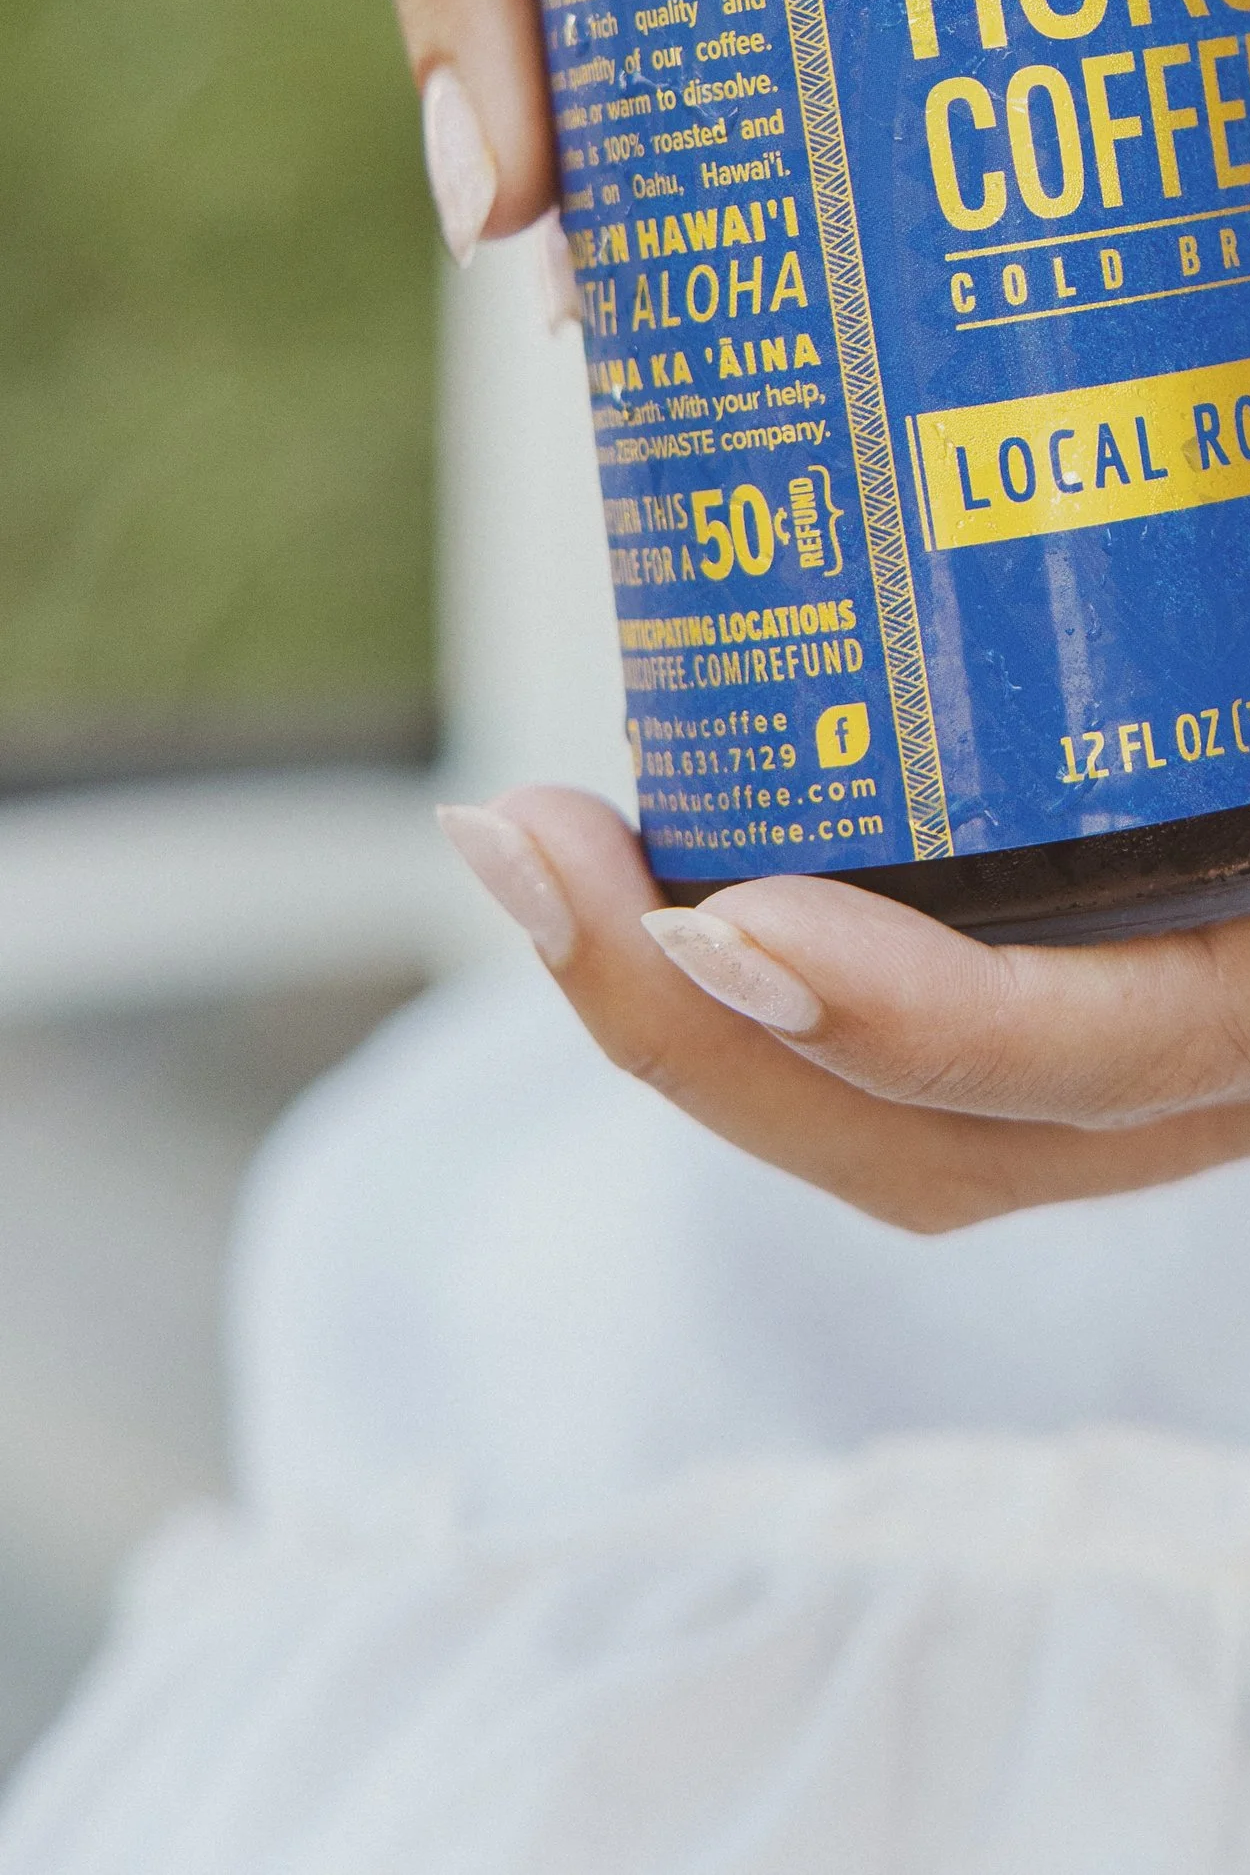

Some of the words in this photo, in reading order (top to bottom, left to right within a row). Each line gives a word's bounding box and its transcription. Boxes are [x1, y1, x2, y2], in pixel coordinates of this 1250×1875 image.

[624, 47, 641, 74] of
[652, 45, 683, 70] our
[696, 30, 773, 62] coffee.
[607, 93, 652, 121] warm
[656, 87, 676, 111] to
[684, 71, 779, 108] dissolve.
[604, 133, 646, 165] 100%
[652, 117, 727, 154] roasted
[741, 108, 785, 141] and
[602, 184, 620, 206] on
[632, 171, 684, 200] Oahu,
[701, 150, 791, 189] Hawai'i.
[636, 196, 799, 260] HAWAI'I
[632, 250, 808, 332] ALOHA
[950, 248, 1124, 314] COLD
[651, 351, 693, 388] KA
[705, 333, 821, 379] 'ĀINA
[667, 394, 709, 420] With
[713, 390, 761, 422] your
[765, 379, 826, 409] help,
[615, 429, 716, 465] ZERO-WASTE
[721, 419, 831, 452] company.
[956, 416, 1169, 511] LOCAL
[643, 492, 688, 532] THIS
[788, 477, 825, 569] REFUND
[642, 546, 676, 584] FOR
[681, 544, 696, 581] A
[718, 599, 857, 645] LOCATIONS
[1060, 730, 1110, 784] 12
[1118, 721, 1168, 774] FL
[1175, 708, 1226, 763] OZ
